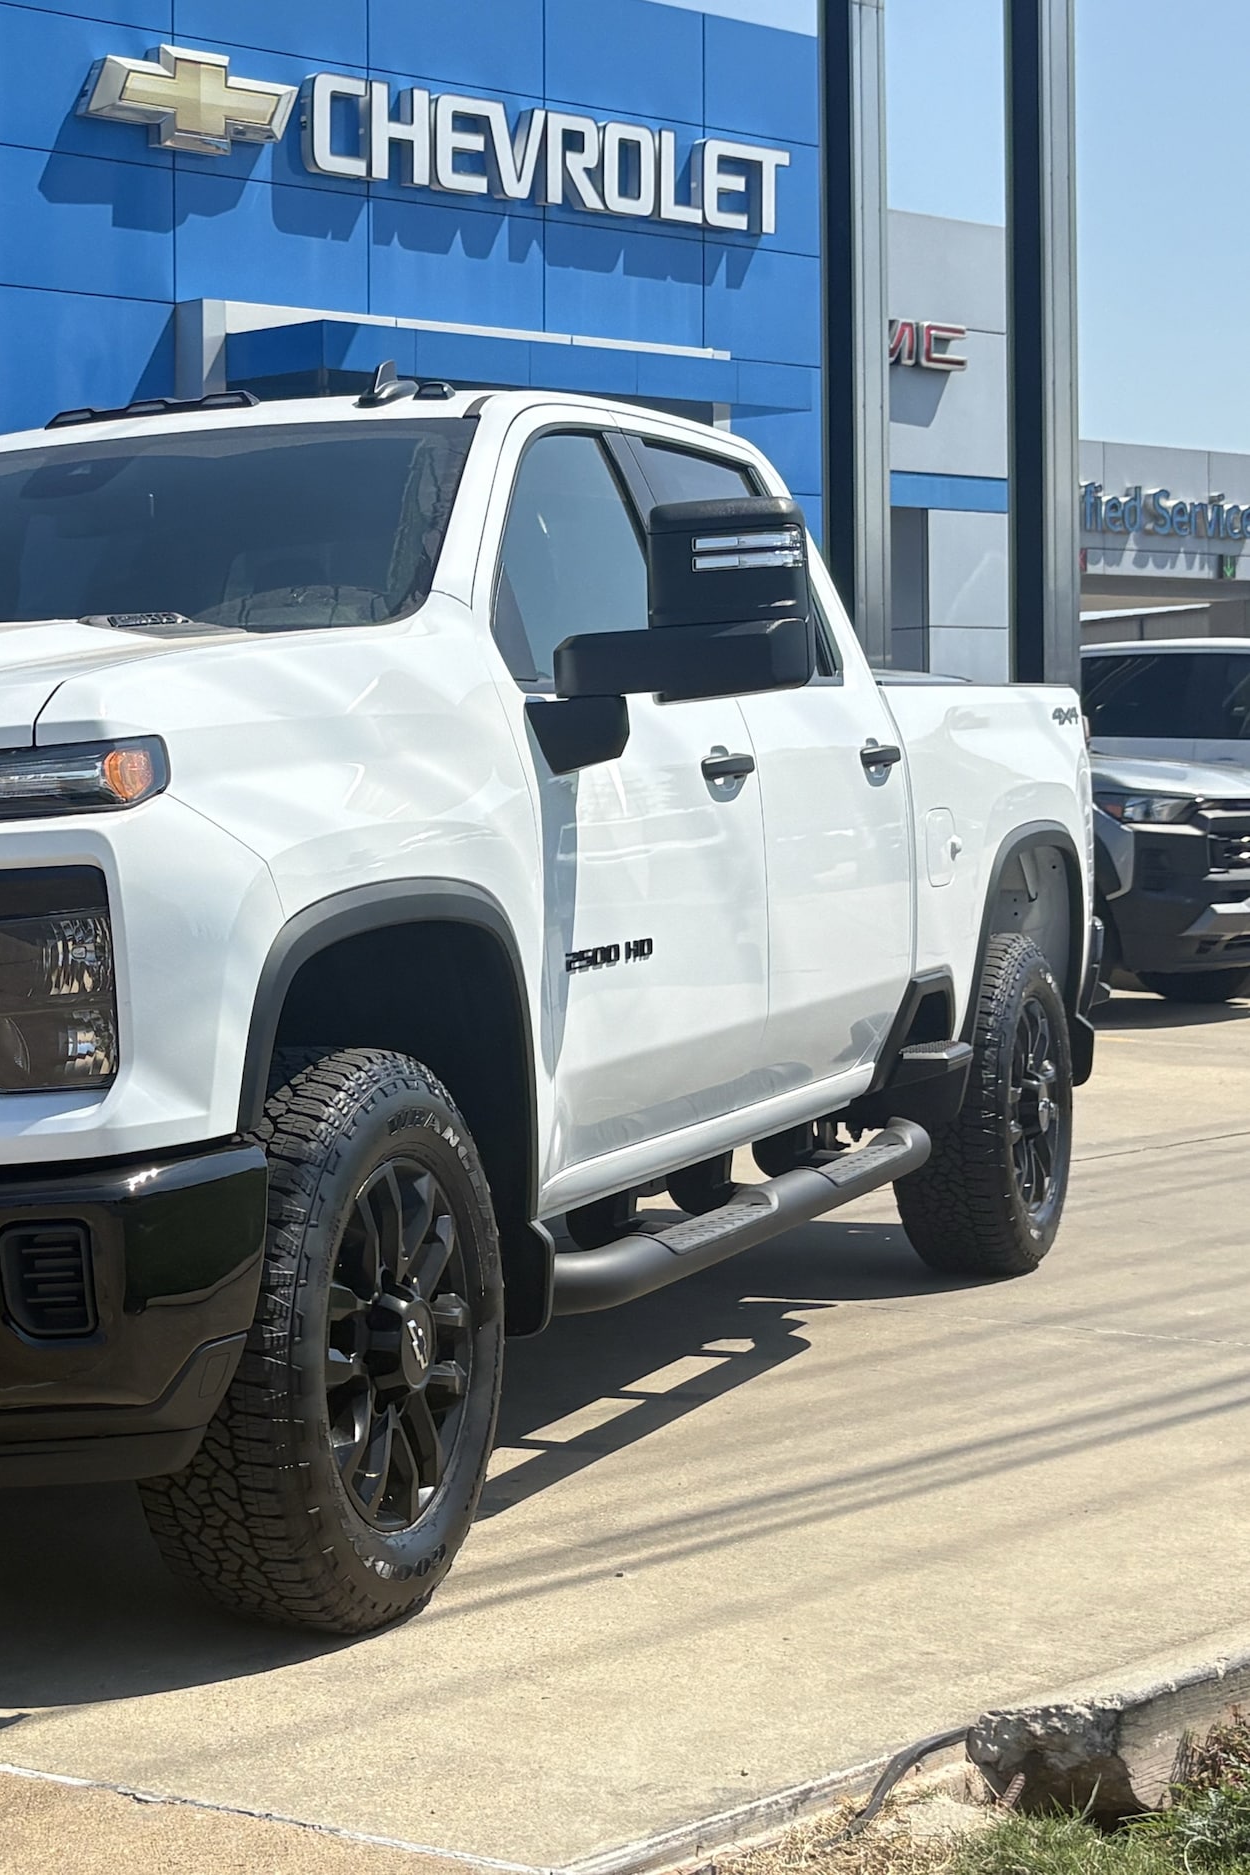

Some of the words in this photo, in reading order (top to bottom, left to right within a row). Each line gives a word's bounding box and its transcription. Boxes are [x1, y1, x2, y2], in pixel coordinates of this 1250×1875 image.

[301, 71, 790, 234] CHEVROLET
[565, 943, 620, 972] 2500
[624, 937, 653, 962] HD
